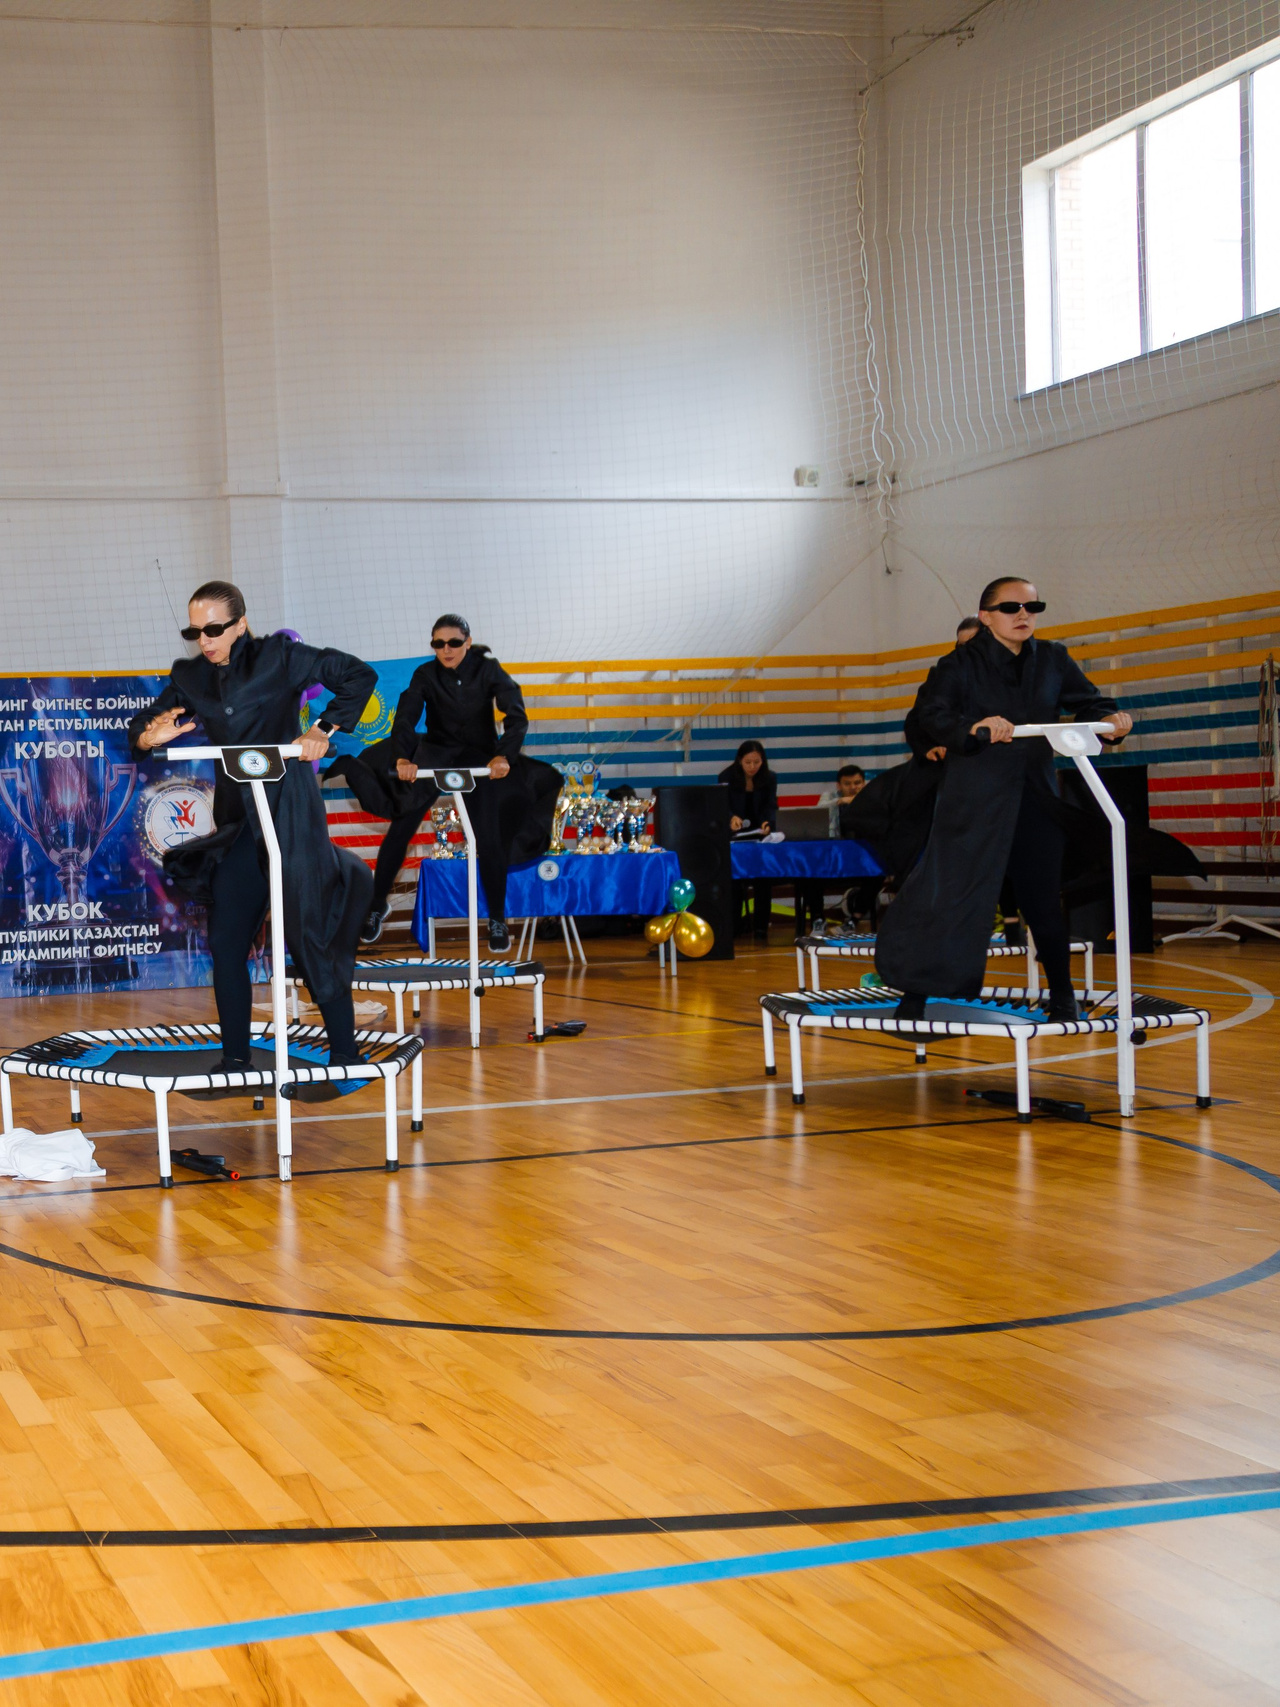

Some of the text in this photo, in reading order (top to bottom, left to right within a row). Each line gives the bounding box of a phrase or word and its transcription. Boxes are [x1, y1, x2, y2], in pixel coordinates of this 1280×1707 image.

[32, 697, 93, 712] ФИТНЕС
[96, 694, 158, 710] БОЙЫН
[28, 717, 131, 732] РЕСПУБЛИКАС
[15, 740, 105, 760] КУБОГЫ
[27, 902, 105, 921] КУБОК
[73, 924, 160, 941] КАЗАХСТАН
[1, 946, 91, 964] ДЖАМПИНГ
[93, 942, 163, 958] ФИТНЕСУ
